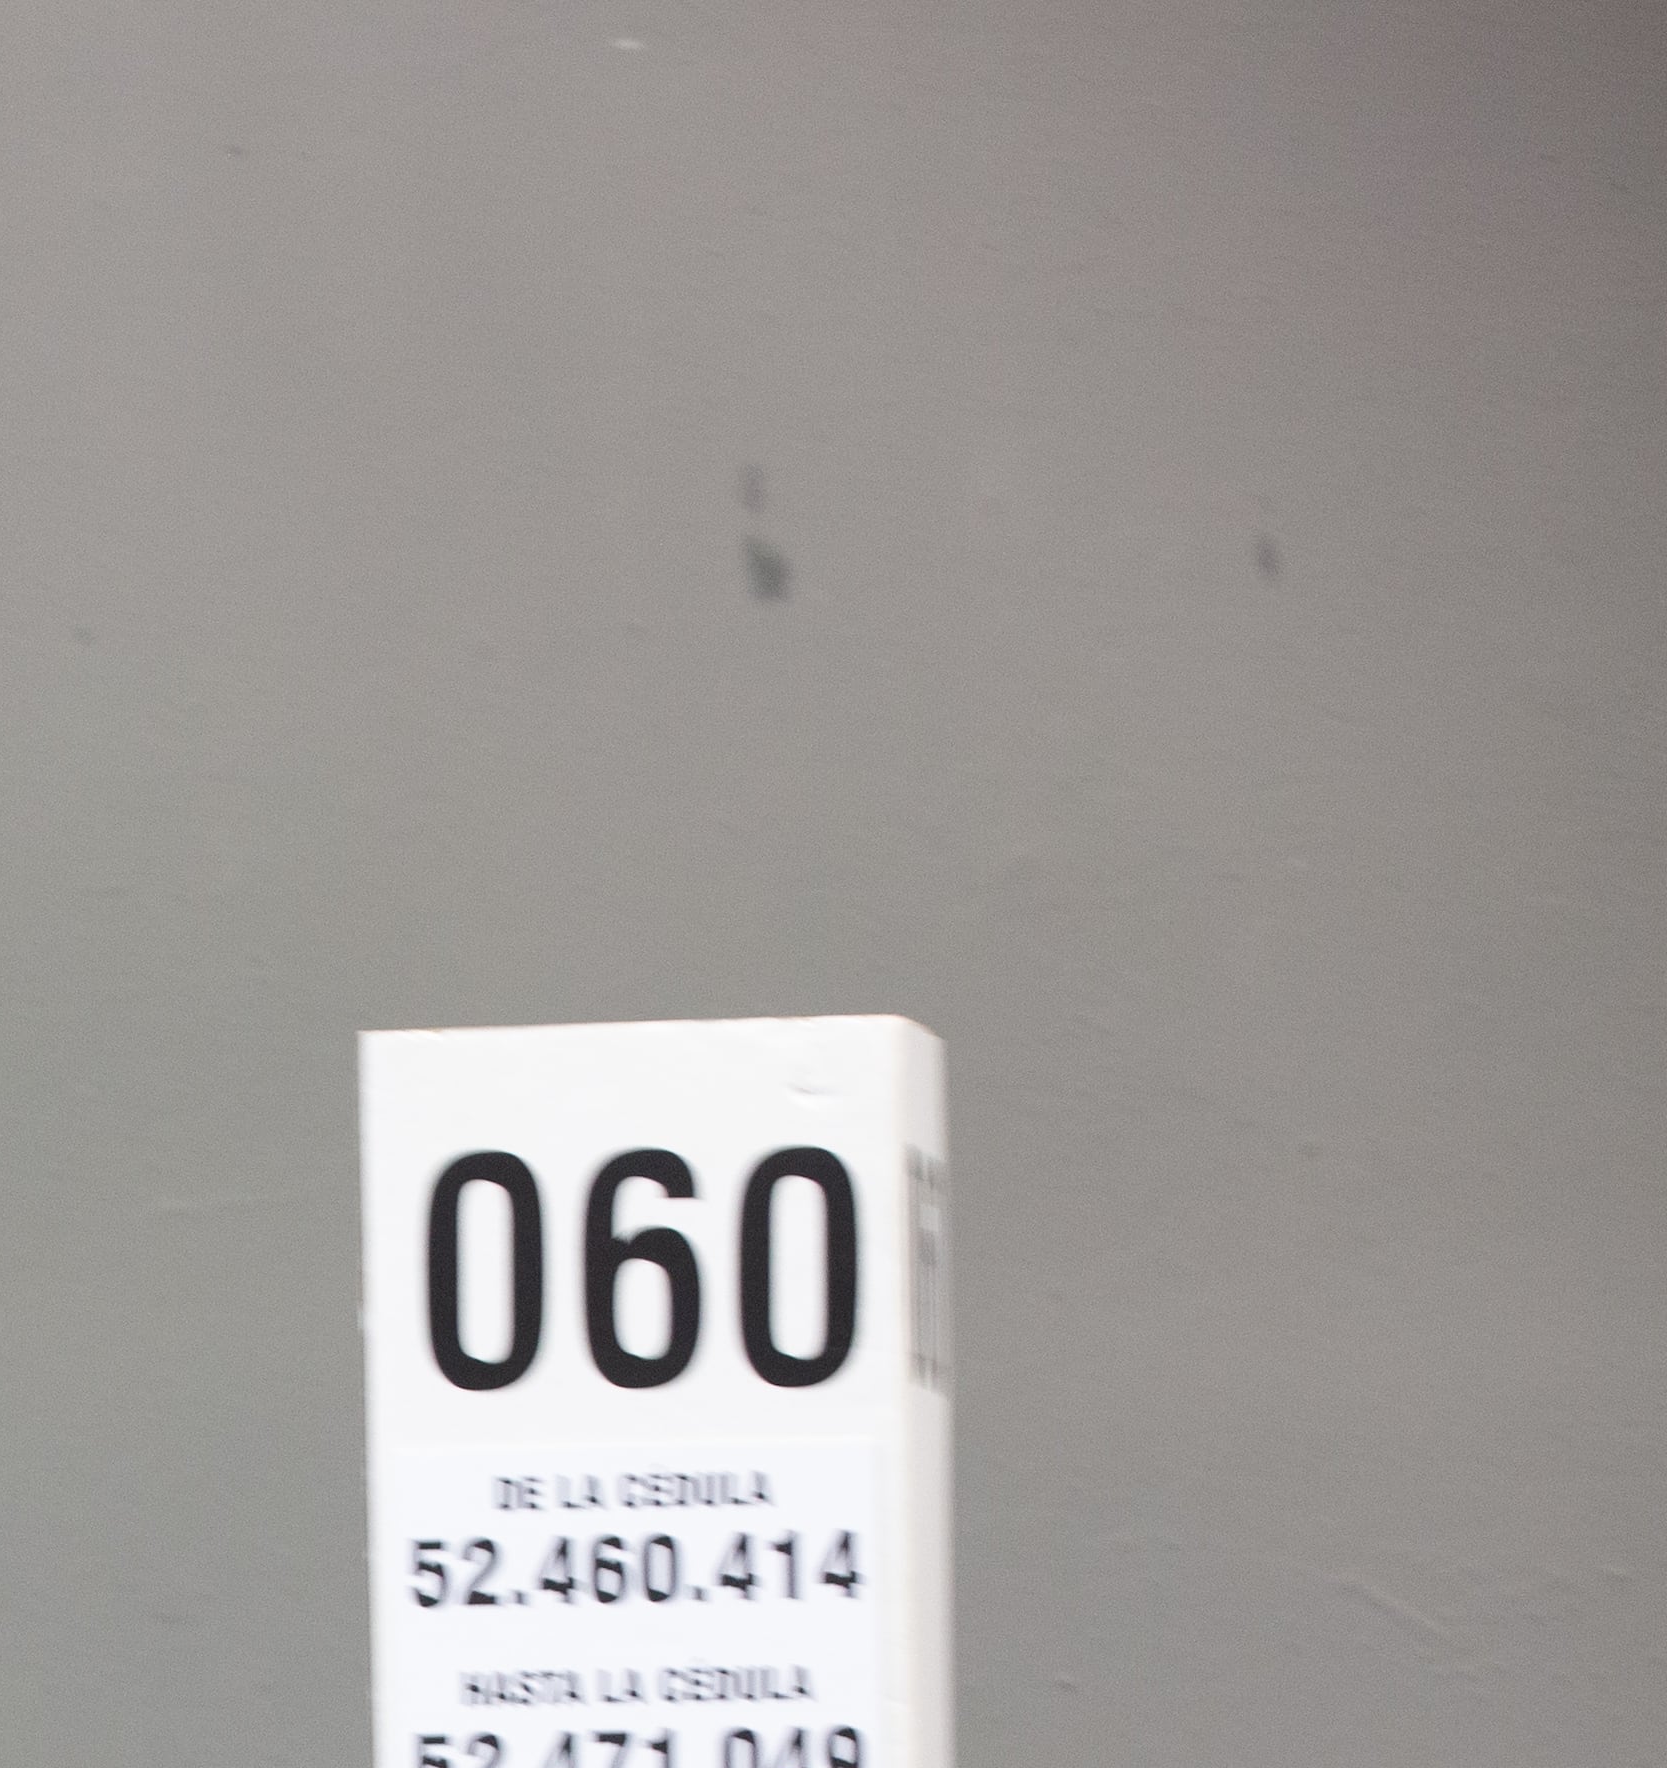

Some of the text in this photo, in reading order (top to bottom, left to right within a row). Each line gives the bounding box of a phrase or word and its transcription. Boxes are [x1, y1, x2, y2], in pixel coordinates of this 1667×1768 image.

[426, 1145, 859, 1392] 060
[492, 1474, 544, 1511] DE
[555, 1473, 607, 1511] LA
[411, 1529, 863, 1608] 52.460.414
[460, 1668, 588, 1709] HASTA
[596, 1666, 648, 1706] LA
